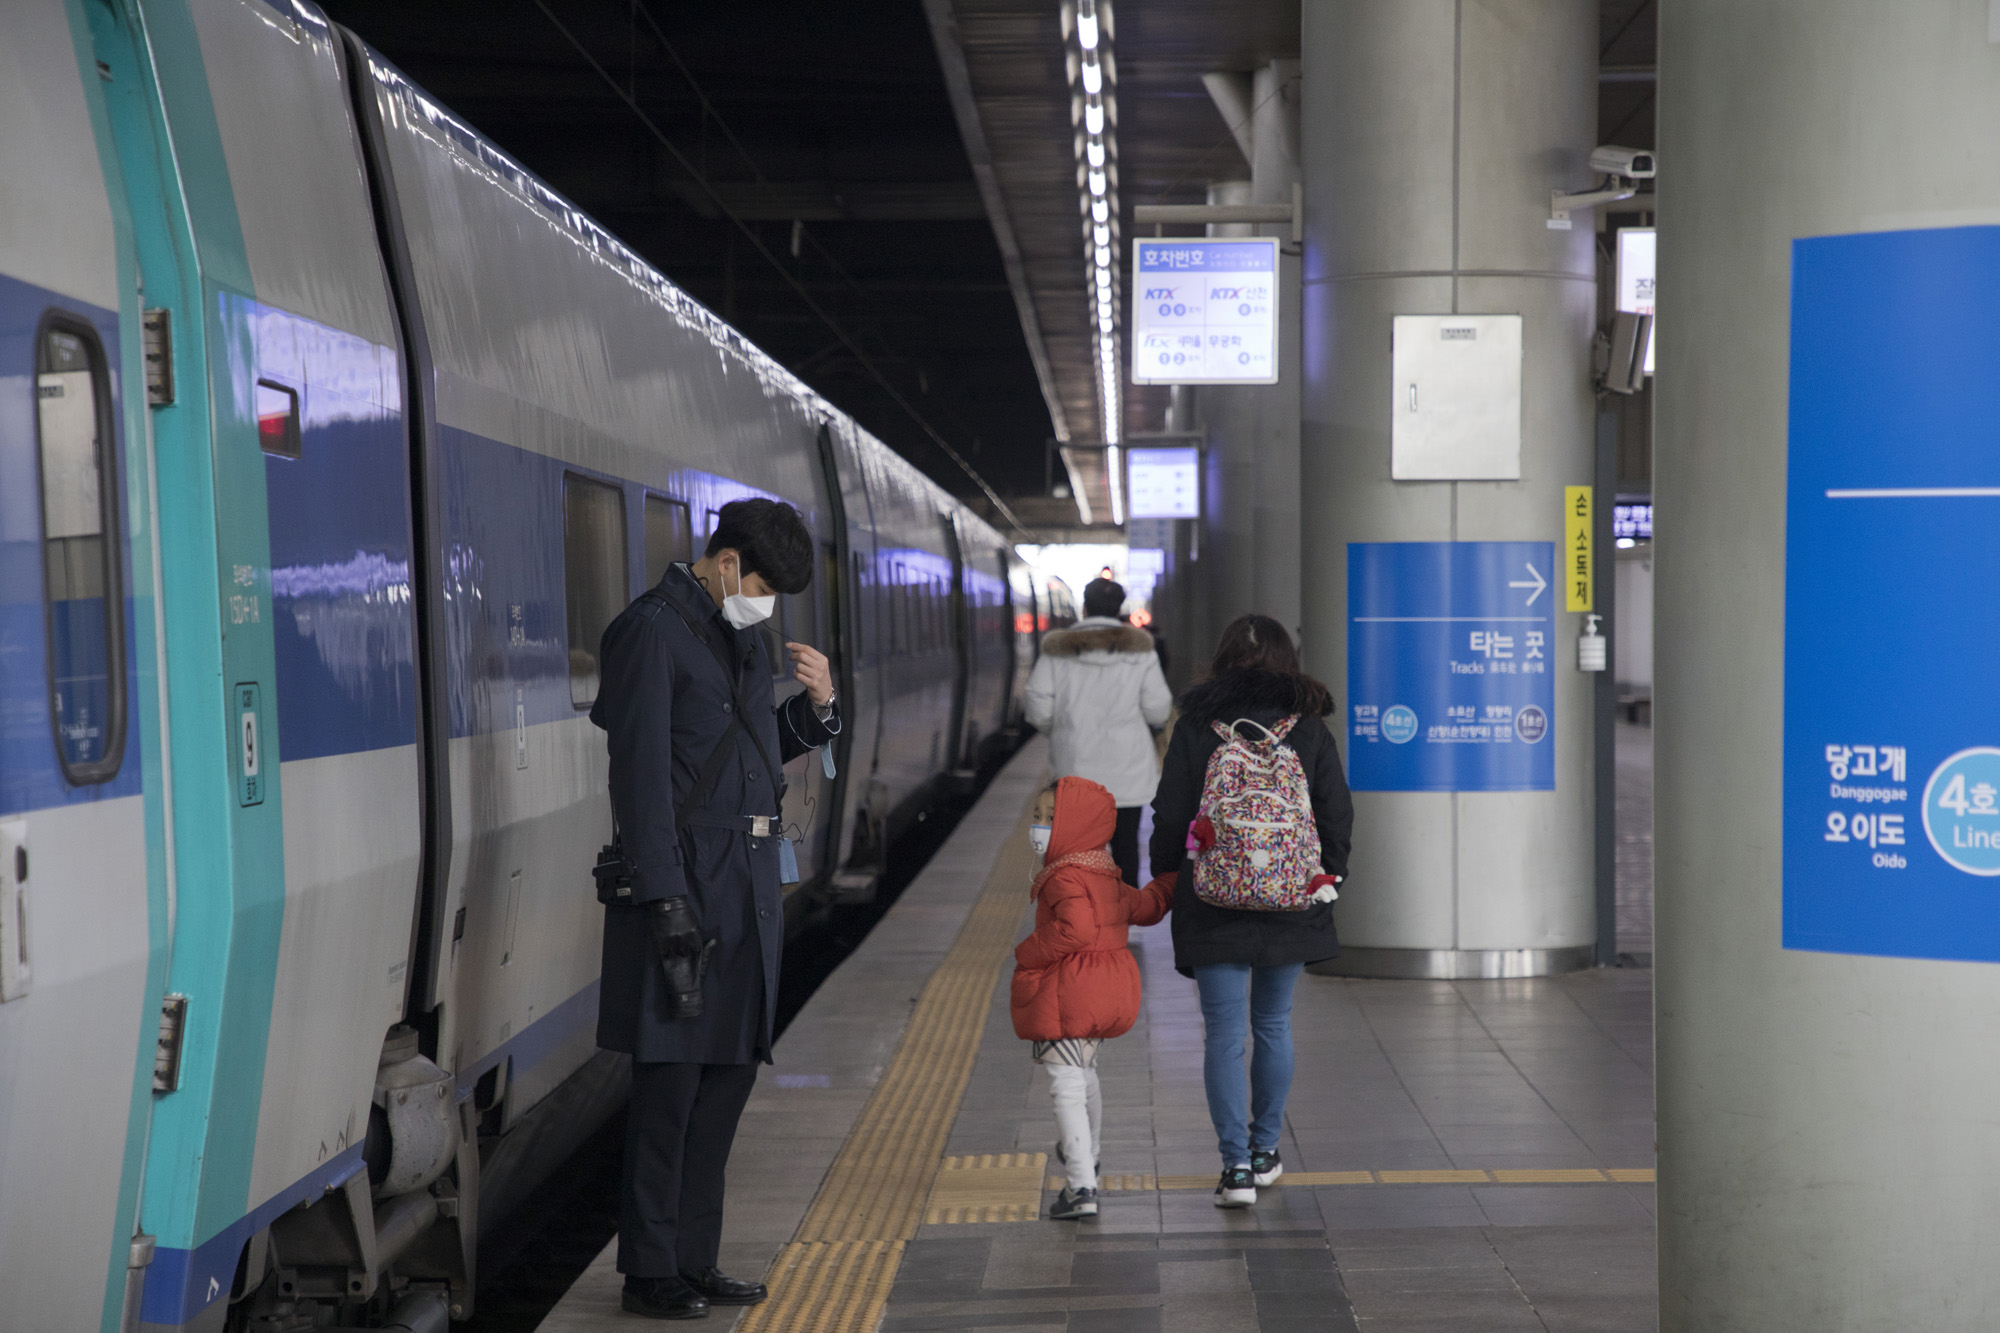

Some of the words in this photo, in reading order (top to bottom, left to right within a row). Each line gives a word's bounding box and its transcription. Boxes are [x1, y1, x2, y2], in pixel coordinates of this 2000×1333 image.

[1144, 249, 1204, 268] 호차번호
[1145, 286, 1182, 300] KTX
[1210, 286, 1245, 300] KTX
[1576, 493, 1587, 517] 손
[1576, 528, 1588, 605] 소독제
[1470, 630, 1514, 658] 타는
[1525, 630, 1544, 659] 곳
[1450, 660, 1485, 675] Tracks
[1825, 745, 1906, 782] 당고개
[1830, 784, 1907, 803] Danggogae
[1824, 811, 1906, 849] 오이도
[1872, 852, 1907, 869] Oido
